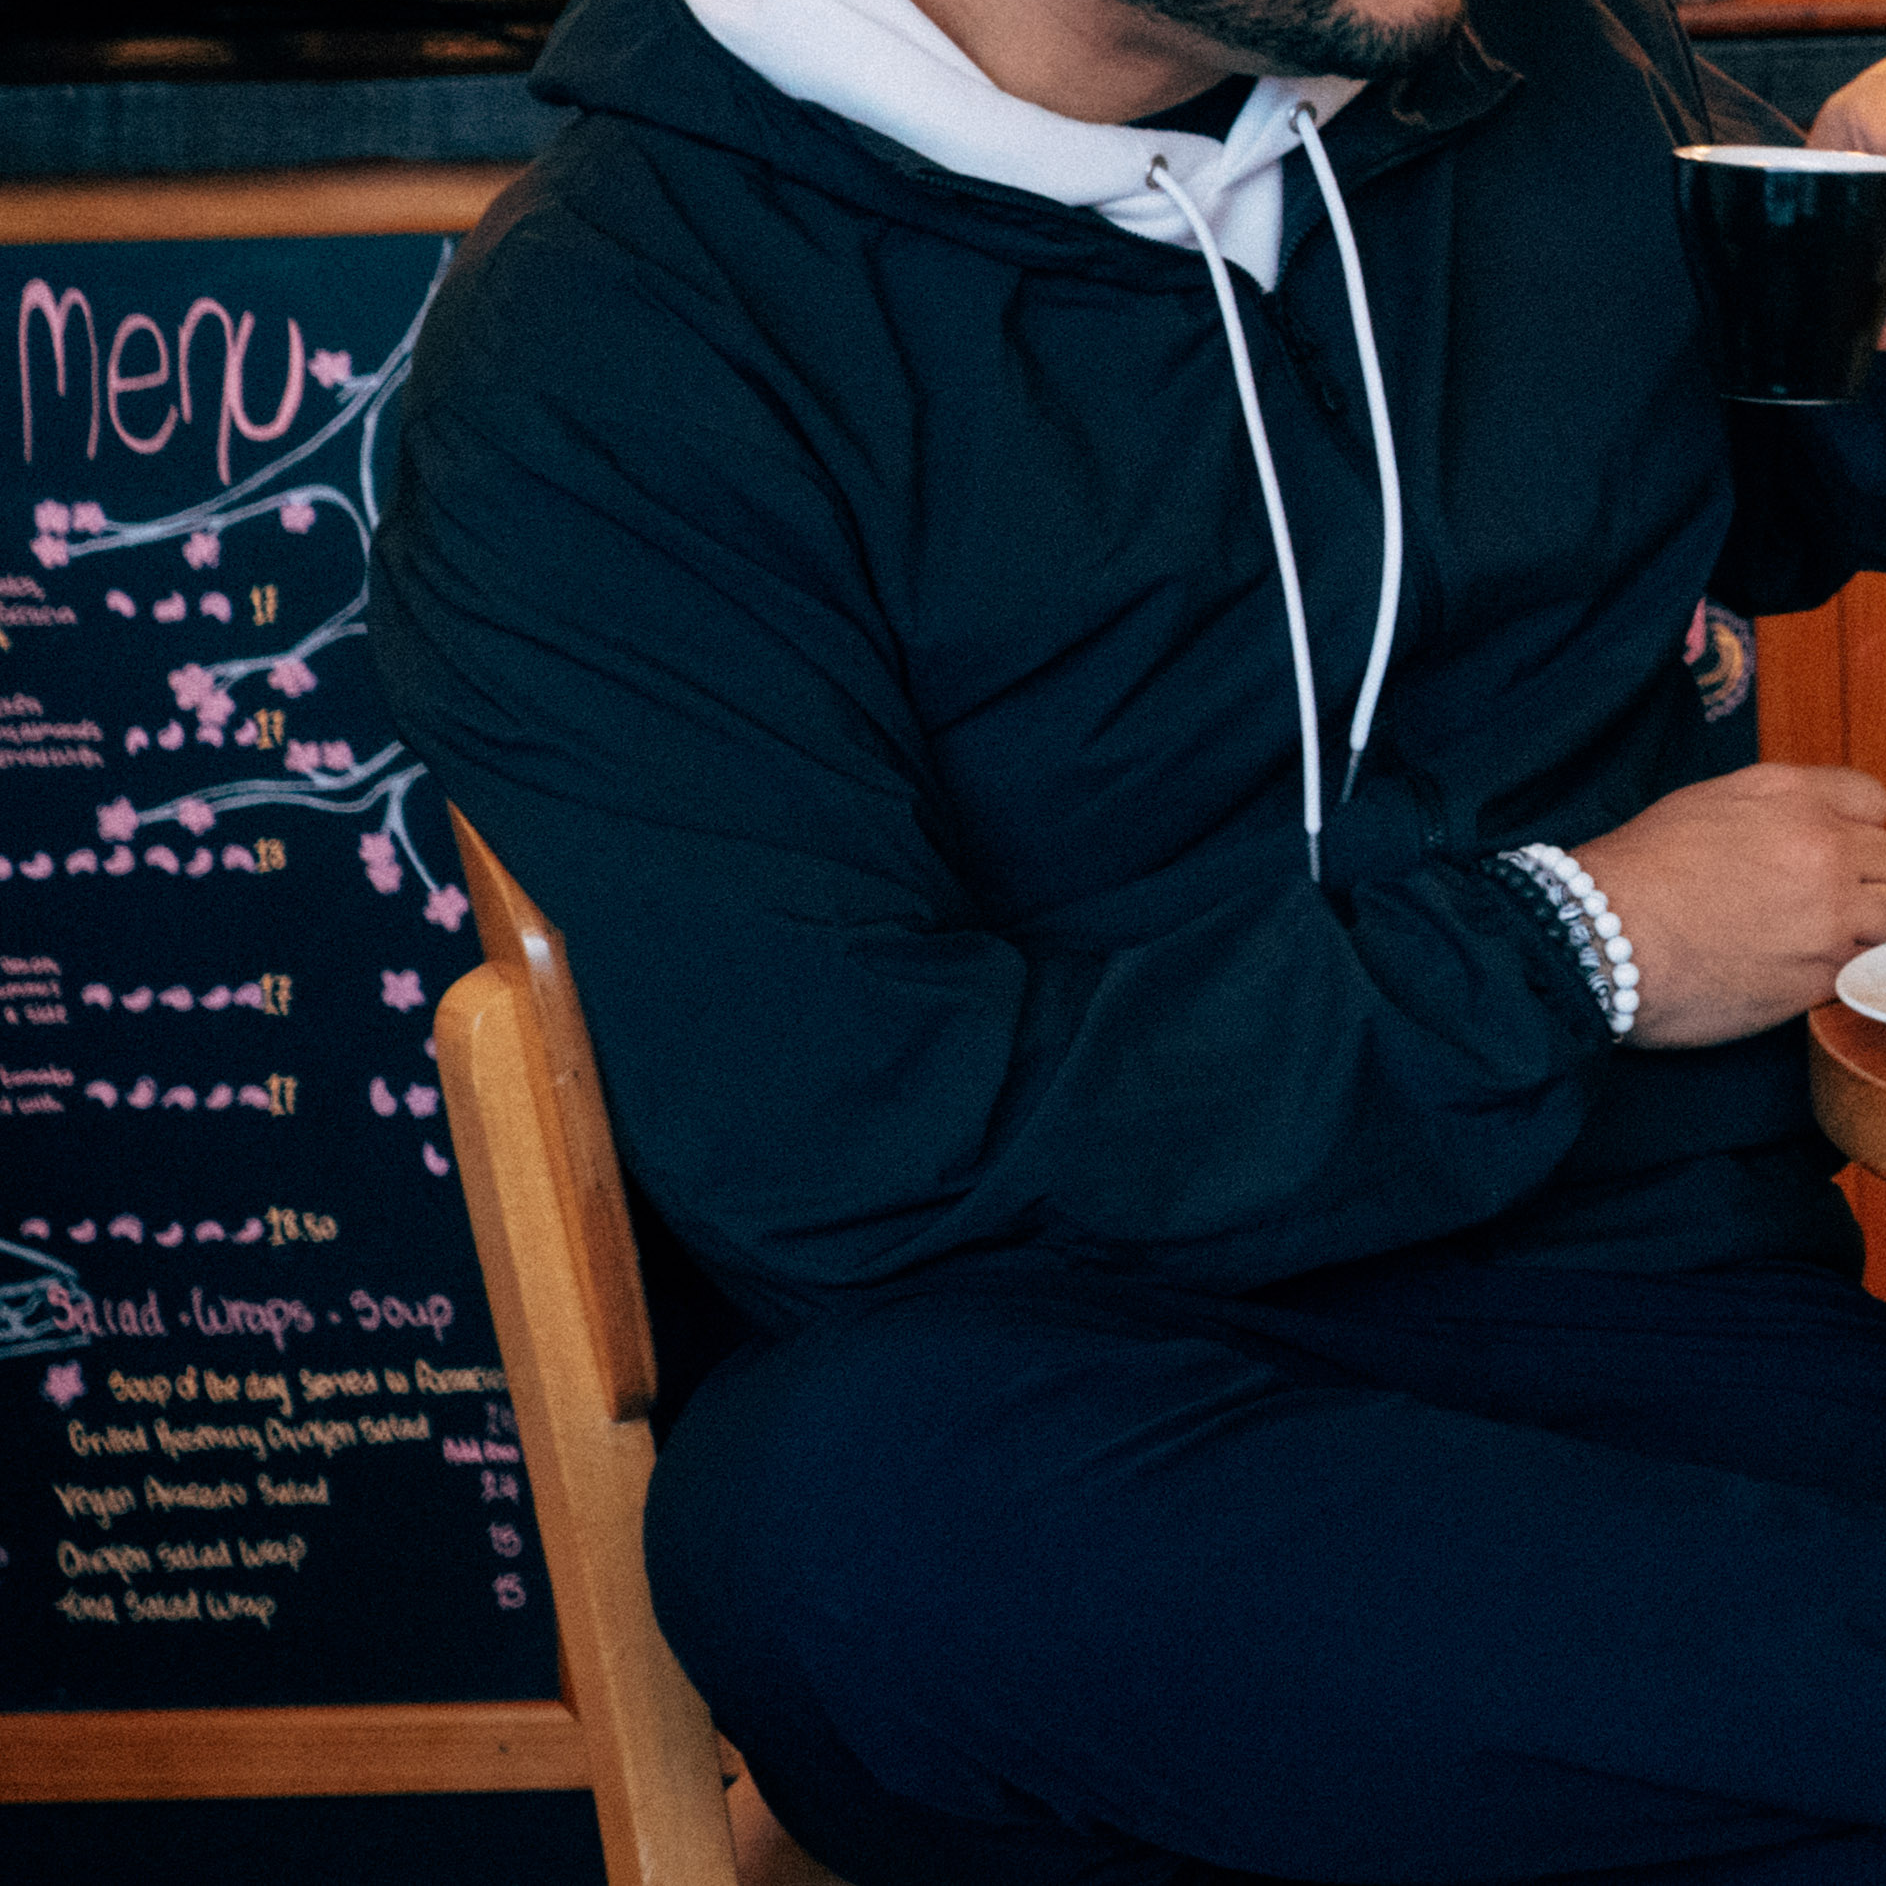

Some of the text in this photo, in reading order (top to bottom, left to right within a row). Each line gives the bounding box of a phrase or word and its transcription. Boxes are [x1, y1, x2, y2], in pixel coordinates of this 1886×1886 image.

[18, 277, 305, 486] Menu
[47, 1284, 455, 1352] Salad Wraps Soup
[109, 1366, 172, 1407] Soup
[176, 1365, 200, 1401] of
[204, 1368, 240, 1403] the
[245, 1373, 292, 1417] day
[68, 1418, 149, 1457] Grilled
[55, 1481, 137, 1530] Vegan
[144, 1474, 248, 1510] Avocado
